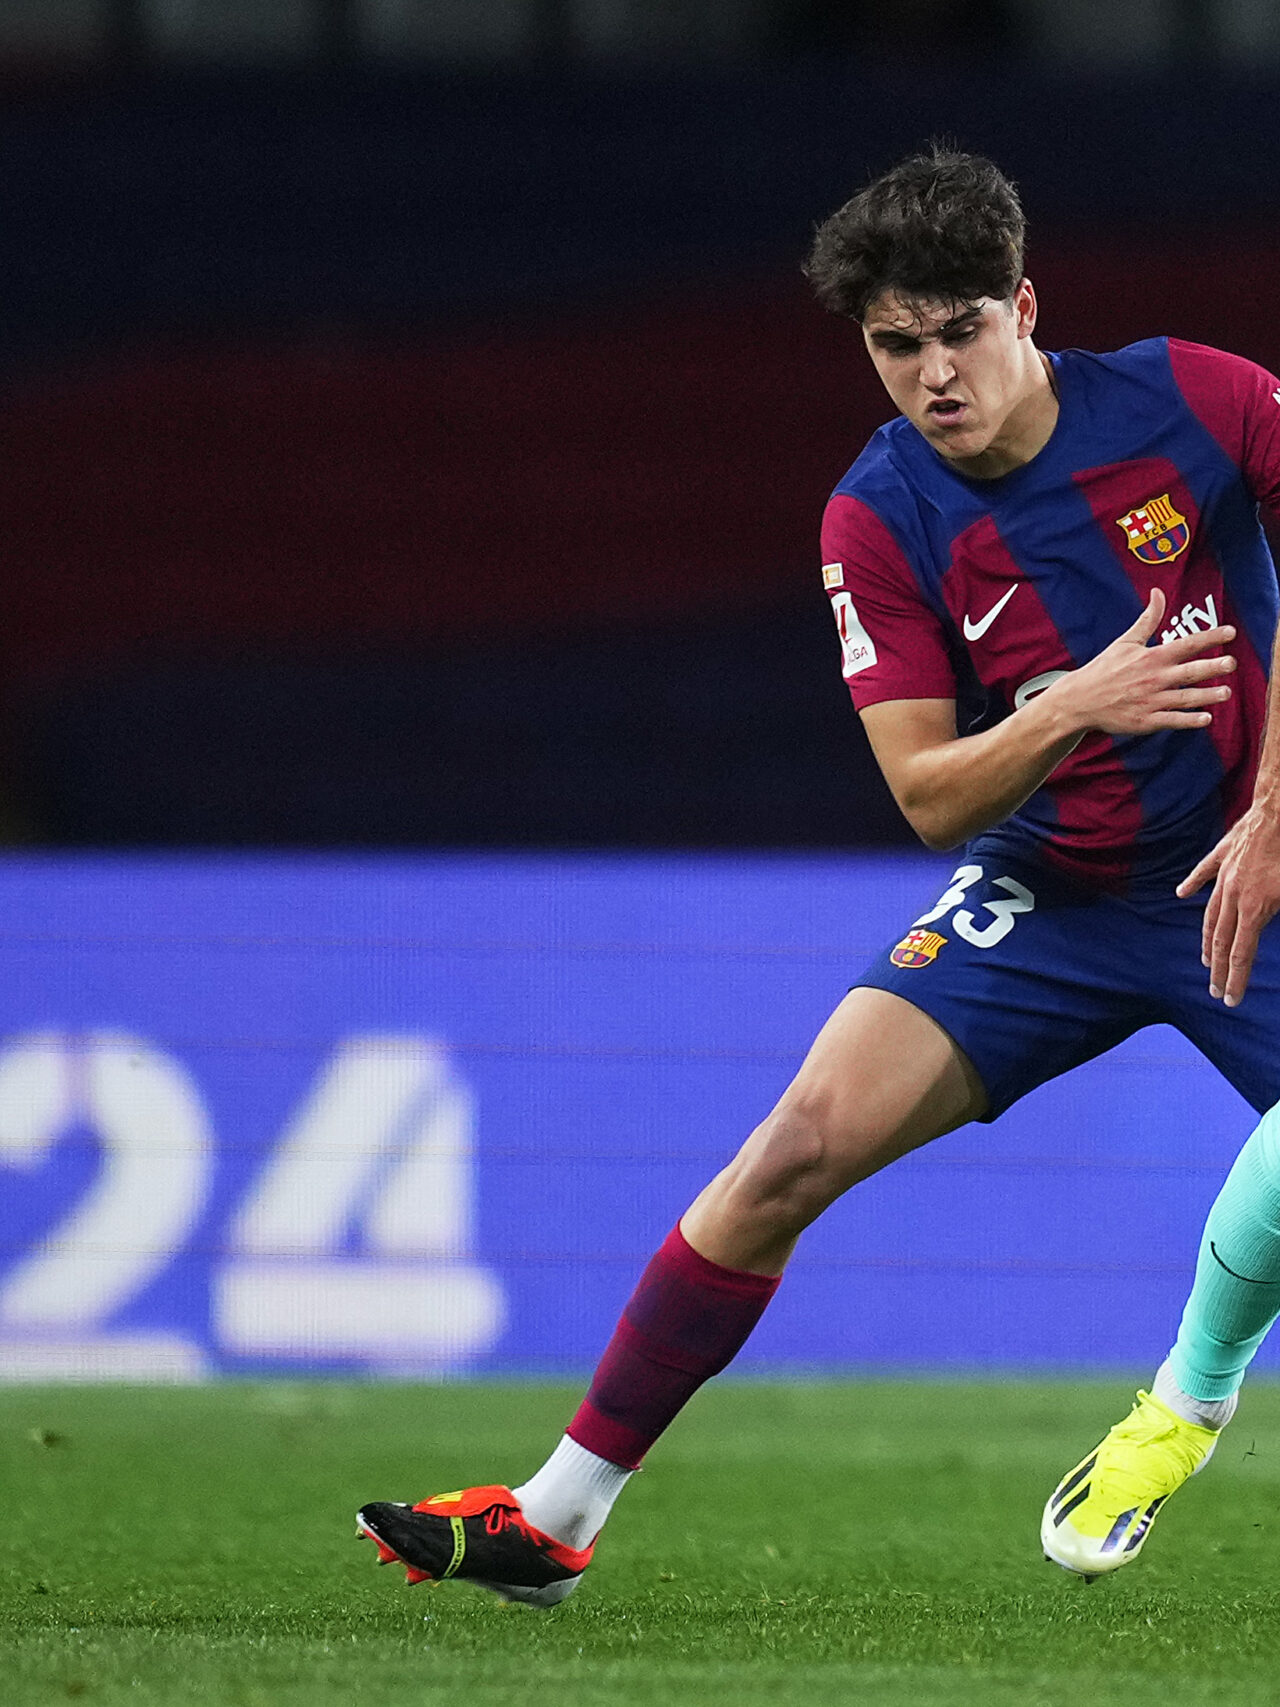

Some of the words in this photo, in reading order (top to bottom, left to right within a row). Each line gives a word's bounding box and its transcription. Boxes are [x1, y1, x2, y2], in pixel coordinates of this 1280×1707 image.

[1161, 594, 1219, 645] tify
[911, 864, 1035, 949] 33
[0, 1030, 508, 1384] 24
